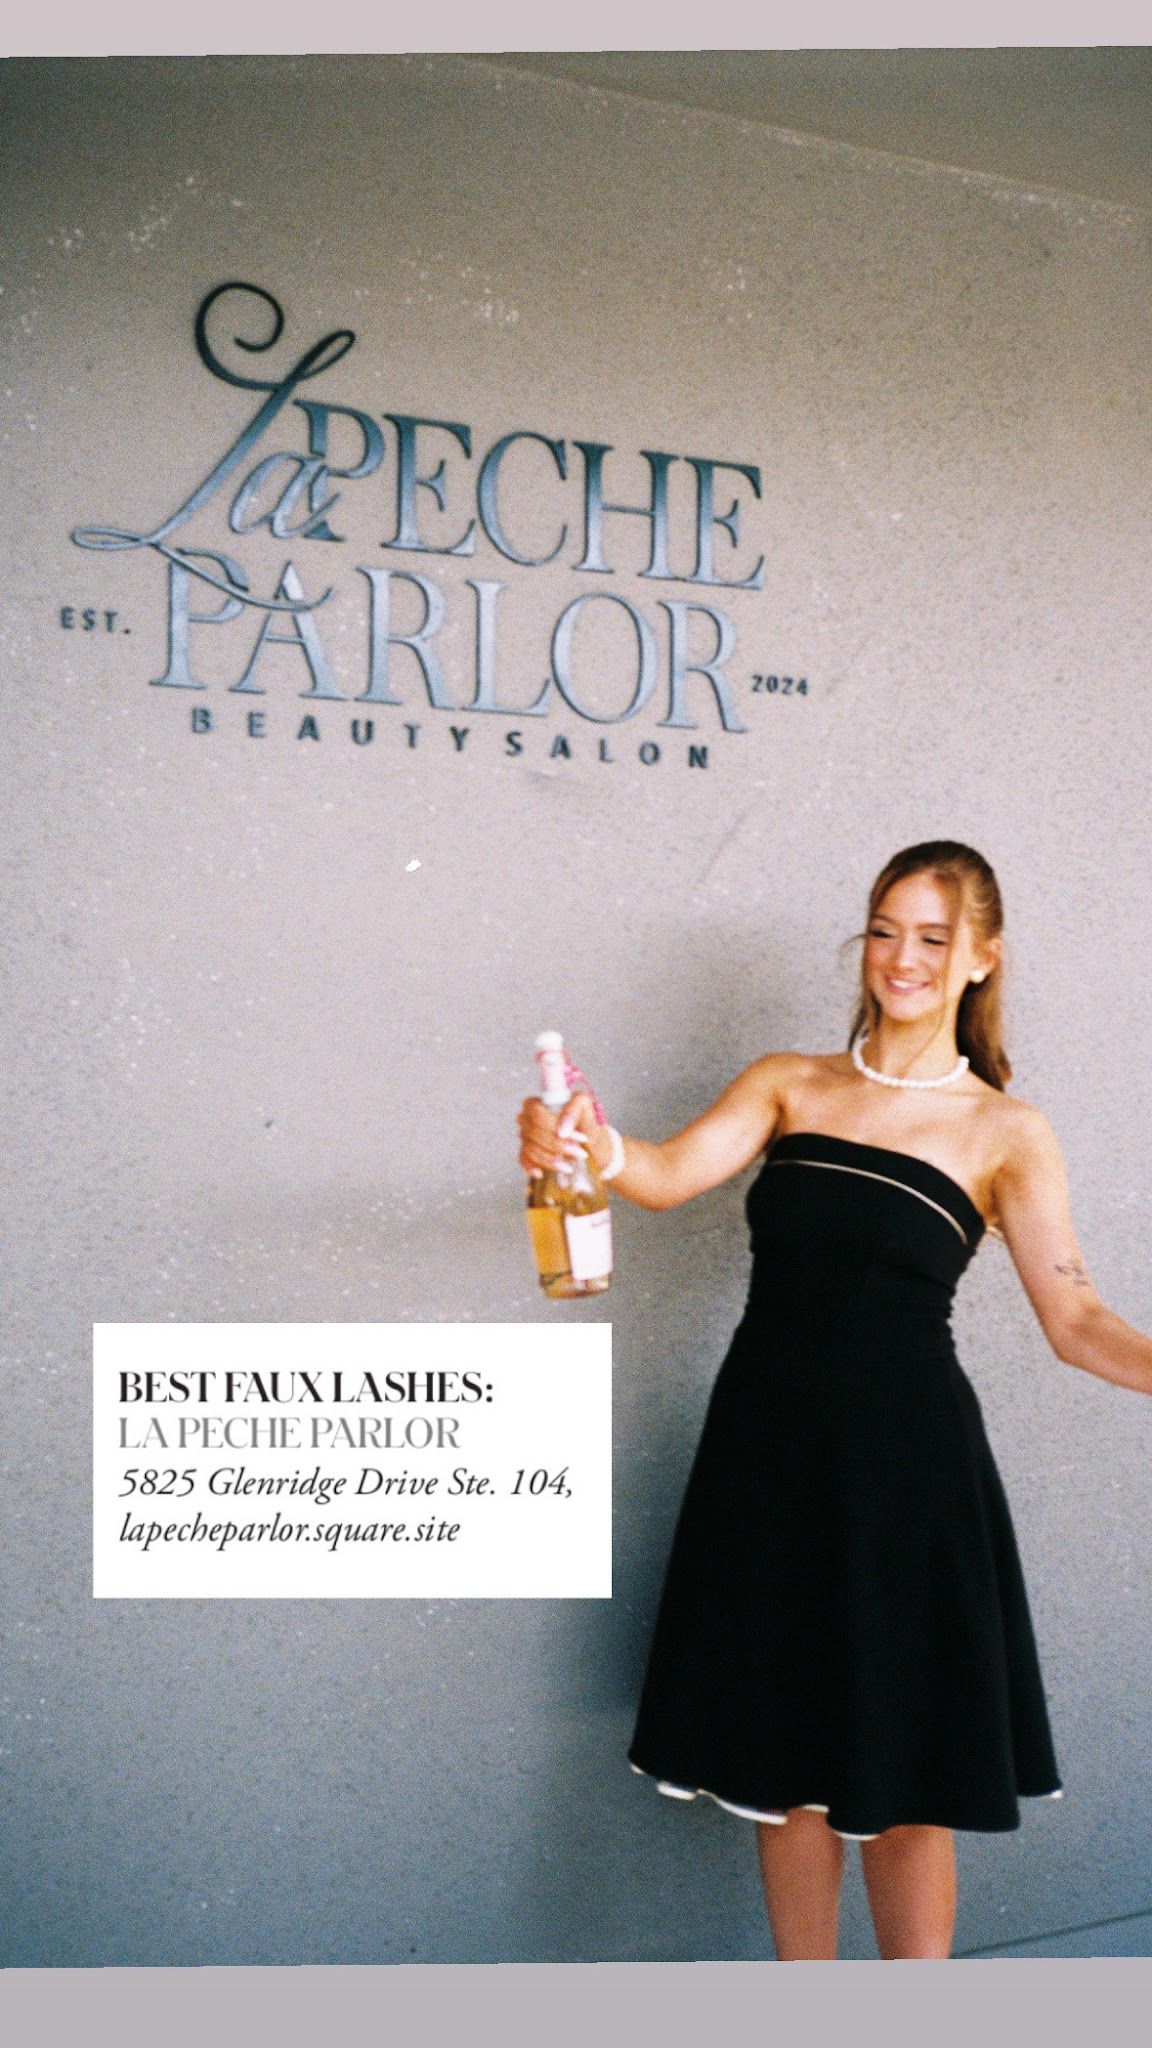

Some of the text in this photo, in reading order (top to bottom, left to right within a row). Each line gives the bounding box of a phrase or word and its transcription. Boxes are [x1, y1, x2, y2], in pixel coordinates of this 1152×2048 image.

[70, 280, 767, 612] La PECHE
[60, 605, 132, 635] EST.
[150, 548, 748, 734] PARLOR
[751, 673, 809, 697] 2024
[190, 706, 711, 770] BEAUTY SALON
